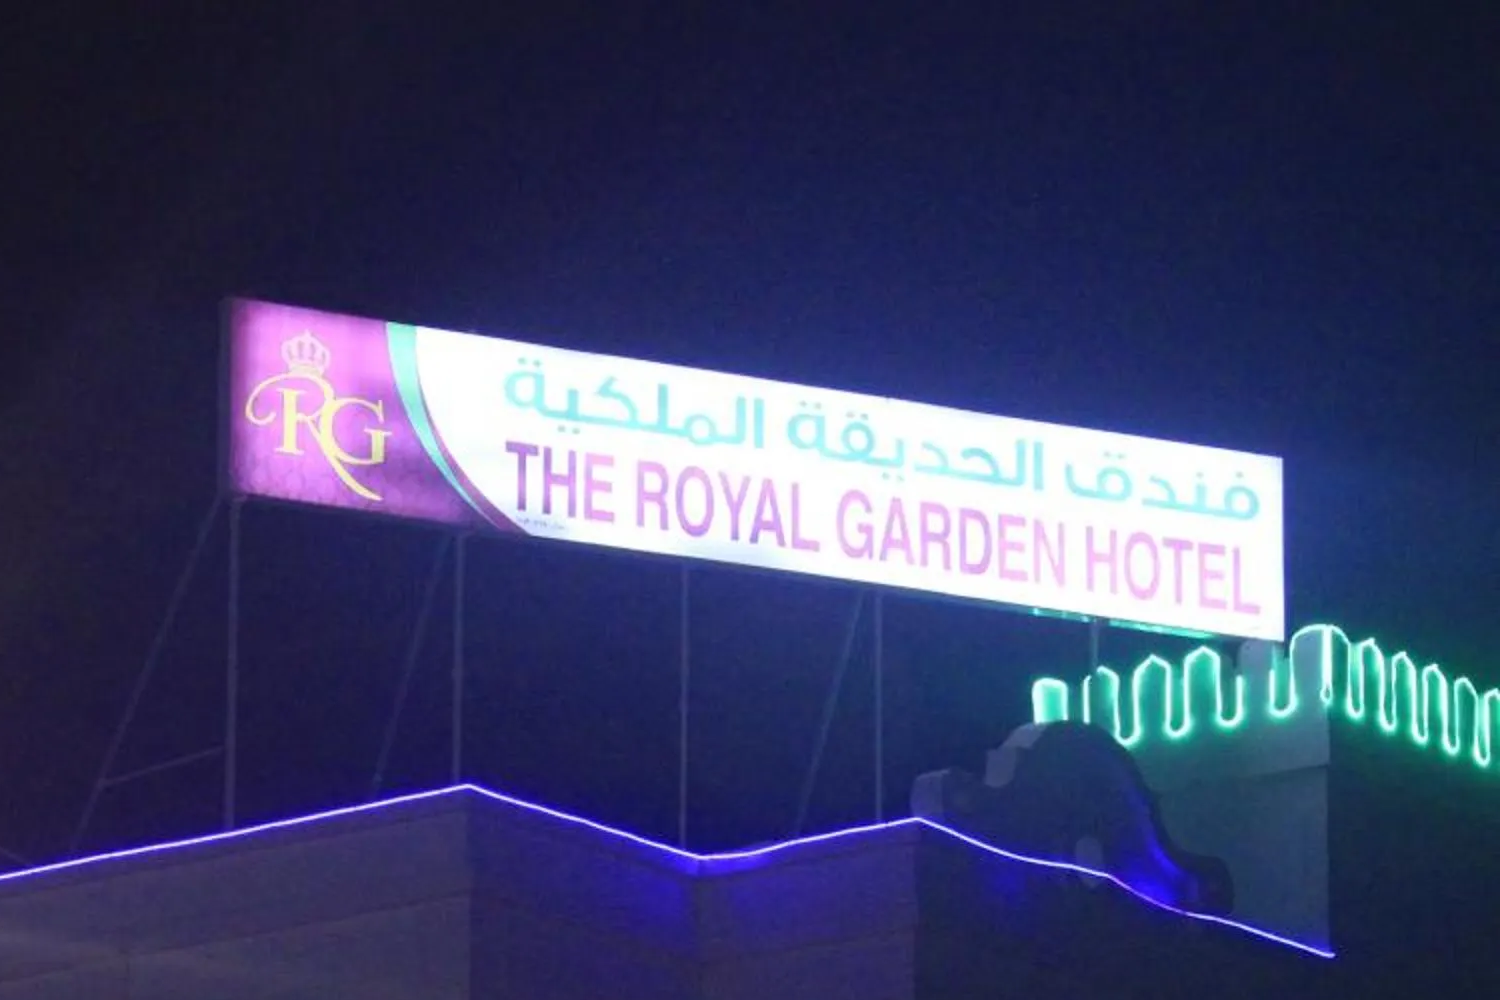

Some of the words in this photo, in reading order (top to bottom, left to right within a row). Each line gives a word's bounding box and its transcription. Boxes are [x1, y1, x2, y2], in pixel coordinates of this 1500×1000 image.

[503, 356, 764, 448] الملكية
[786, 400, 1045, 491] الحديقة
[505, 440, 615, 525] THE
[636, 459, 821, 553] ROYAL
[836, 488, 1066, 588] GARDEN
[1085, 525, 1261, 615] HOTEL
[1064, 450, 1261, 521] فندق
